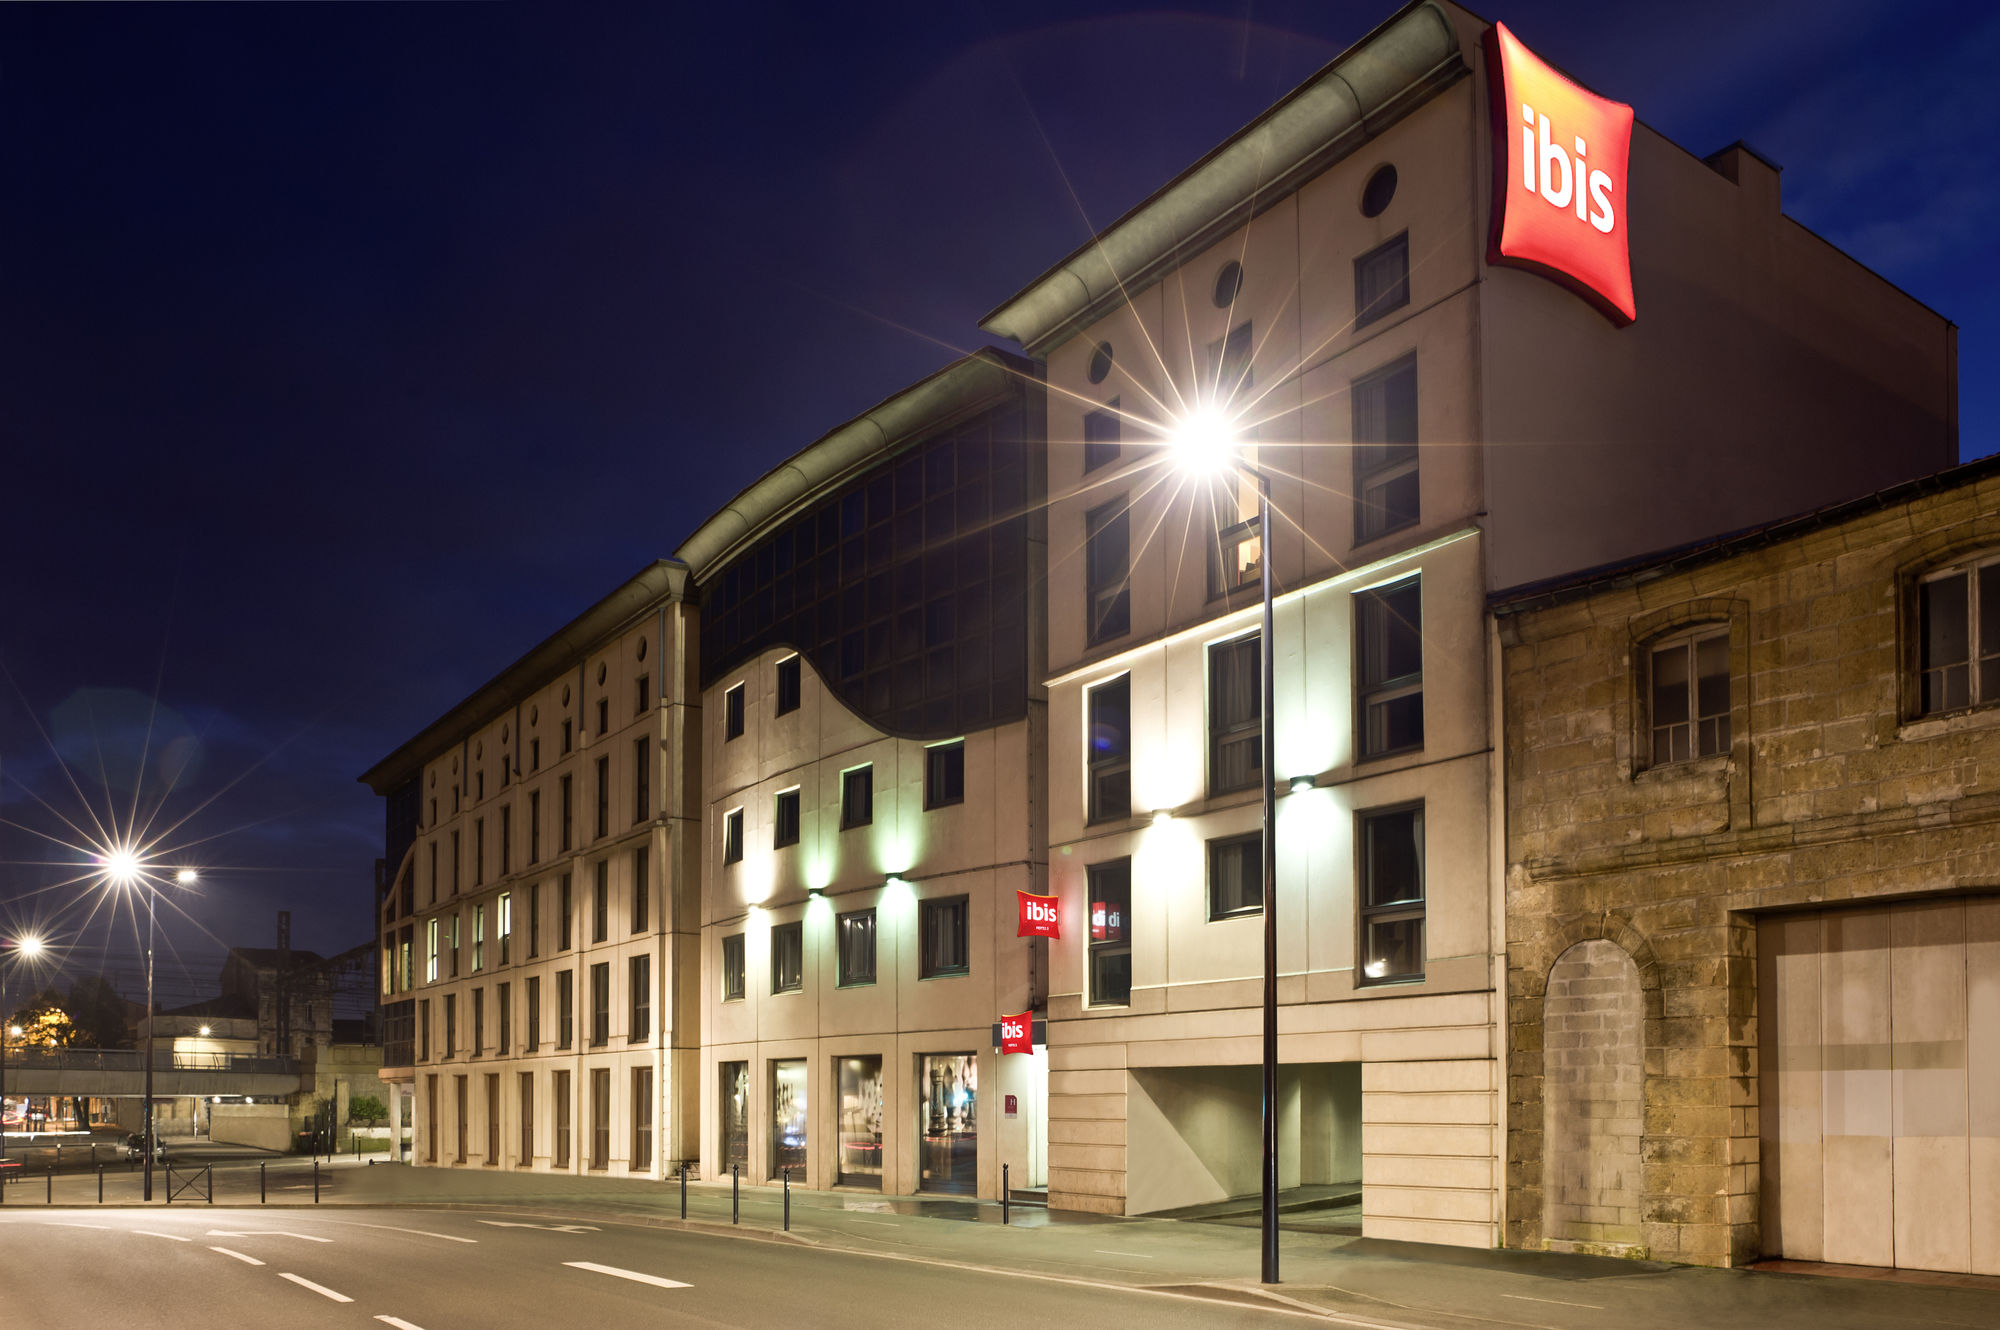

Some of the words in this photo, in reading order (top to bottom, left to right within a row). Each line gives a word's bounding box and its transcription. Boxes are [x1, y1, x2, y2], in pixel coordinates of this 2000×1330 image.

[1522, 103, 1615, 233] ibis
[1026, 901, 1057, 922] ibis
[1001, 1021, 1024, 1039] ibis
